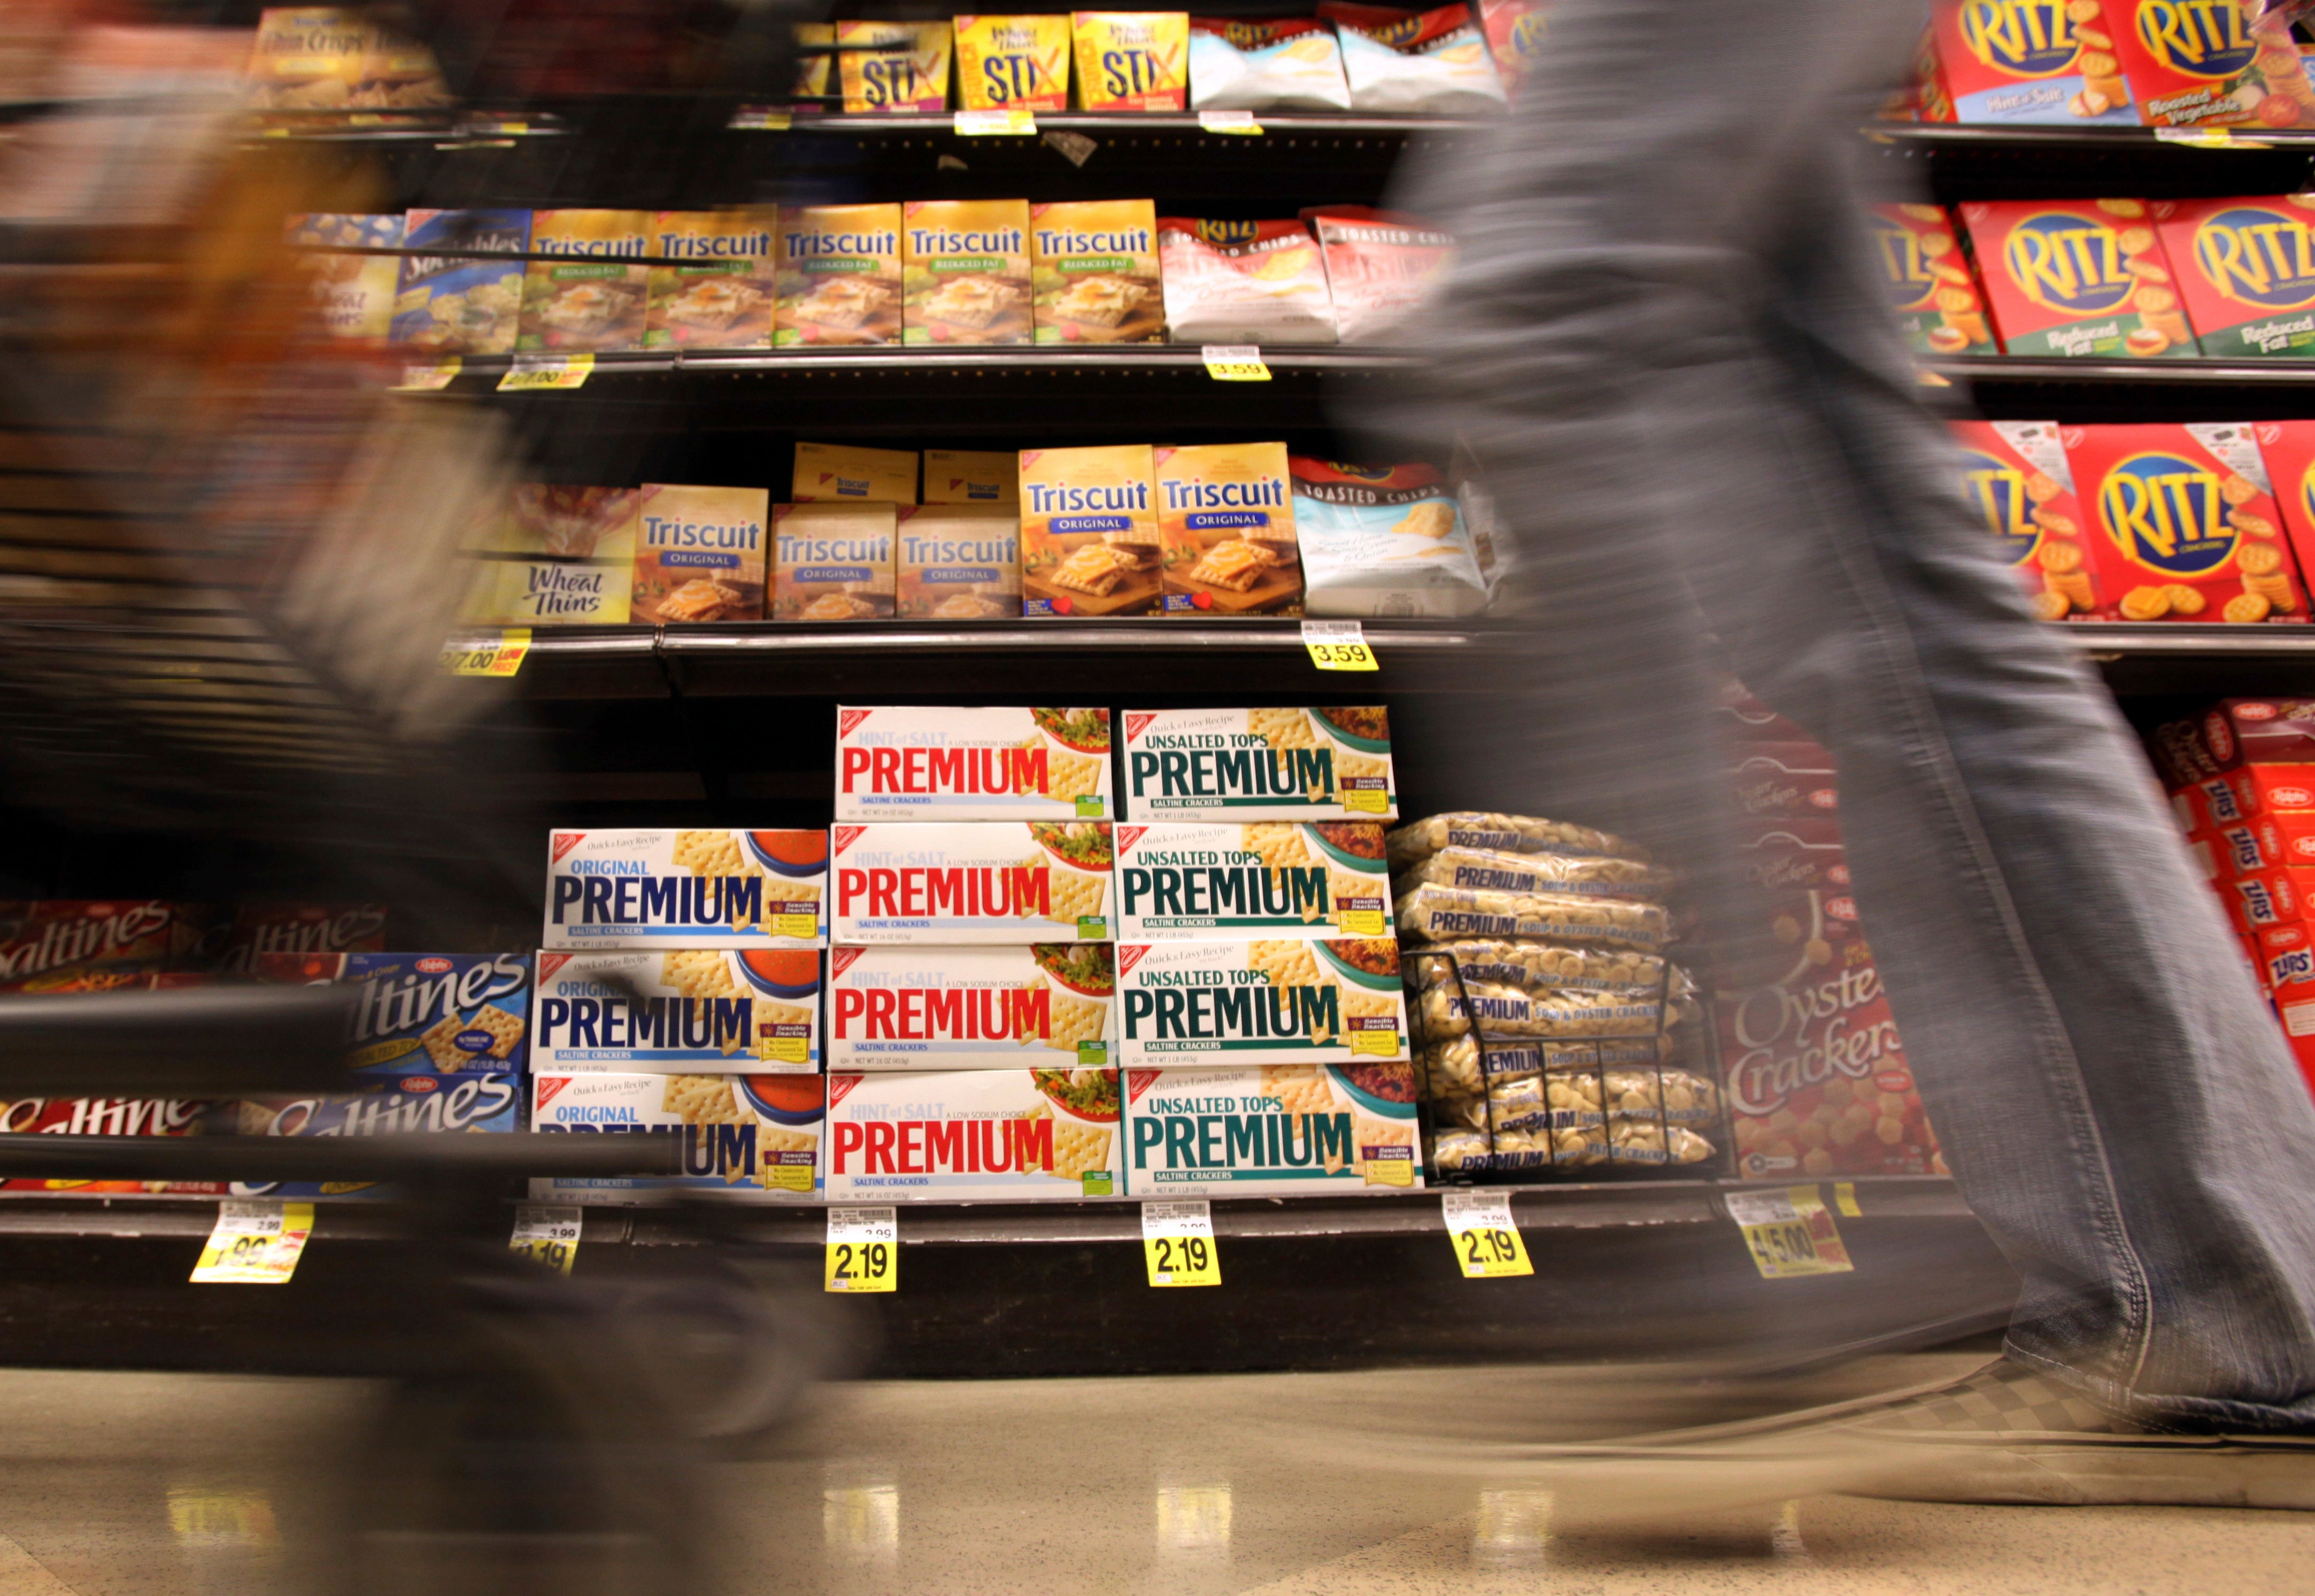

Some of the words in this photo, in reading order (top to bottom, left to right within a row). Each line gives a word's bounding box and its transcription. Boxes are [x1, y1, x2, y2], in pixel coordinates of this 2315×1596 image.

[1962, 0, 2084, 65] RITZ
[2137, 0, 2259, 68] RITZ
[984, 47, 1060, 103] STIX
[1103, 42, 1179, 98] STIX
[537, 234, 646, 257] Triscuit
[660, 230, 770, 256] Triscuit
[785, 229, 894, 257] Triscuit
[910, 227, 1022, 255] Triscuit
[1037, 225, 1149, 256] Triscuit
[1339, 227, 1410, 244] TOASTED
[936, 259, 980, 269] REDUCED
[982, 259, 999, 269] FAT
[1063, 259, 1109, 269] REDUCED
[1112, 259, 1129, 269] FAT
[2008, 226, 2133, 302] RITZ
[2197, 222, 2315, 298] RITZ
[2046, 321, 2119, 349] Reduced
[2240, 315, 2314, 344] Reduced
[2259, 334, 2289, 354] Fat
[1213, 363, 1262, 374] 3.59
[837, 477, 870, 489] Triscuit
[1027, 479, 1148, 513] Triscuit
[1162, 475, 1283, 508] Triscuit
[1305, 484, 1377, 504] TOASTED
[1387, 486, 1440, 503] CHIPS
[1059, 518, 1122, 529] ORIGINAL
[1195, 514, 1259, 526] ORIGINAL
[2104, 472, 2237, 560] RITZ
[644, 516, 759, 550] Triscuit
[670, 553, 730, 565] ORIGINAL
[776, 534, 889, 562] Triscuit
[904, 535, 1016, 563] Triscuit
[528, 564, 603, 593] Wheat
[804, 569, 861, 579] ORIGINAL
[931, 570, 989, 580] ORIGINAL
[523, 589, 600, 615] Thins
[1314, 644, 1368, 662] 3.59
[858, 732, 894, 746] HINT
[896, 734, 907, 745] of
[909, 732, 947, 746] SALT
[1145, 734, 1224, 749] UNSALTED
[1229, 734, 1269, 747] TOPS
[842, 747, 1049, 793] PREMIUM
[1131, 749, 1334, 797] PREMIUM
[1449, 830, 1521, 849] PREMIUM
[570, 859, 650, 875] ORIGINAL
[854, 852, 891, 867] HINT
[893, 853, 904, 865] of
[907, 852, 945, 866] SALT
[1137, 851, 1218, 866] UNSALTED
[1222, 851, 1263, 865] TOPS
[838, 867, 1051, 916] PREMIUM
[1122, 867, 1330, 916] PREMIUM
[1455, 866, 1536, 892] PREMIUM
[552, 876, 762, 924] PREMIUM
[572, 927, 602, 935] SALTINE
[1178, 919, 1215, 927] CRACKERS
[1431, 911, 1517, 934] PREMIUM
[0, 900, 169, 980] altines
[1145, 953, 1171, 966] Quick
[1179, 949, 1202, 961] Easy
[1203, 945, 1234, 958] Recipe
[557, 981, 635, 997] ORIGIN
[851, 973, 889, 987] HINT
[891, 973, 902, 985] of
[905, 972, 945, 988] SALT
[1139, 970, 1223, 986] UNSALTED
[1228, 969, 1270, 984] TOPS
[351, 953, 526, 1044] ltines
[539, 997, 752, 1048] PREMIUM
[834, 989, 1051, 1039] PREMIUM
[1123, 985, 1340, 1039] PREMIUM
[1147, 1043, 1179, 1051] SALTINE
[1180, 1042, 1221, 1050] CRACKERS
[555, 1106, 638, 1122] ORIGINAL
[850, 1104, 889, 1120] HINT
[890, 1106, 902, 1118] of
[905, 1103, 945, 1120] SALT
[1149, 1098, 1236, 1114] UNSALTED
[1240, 1096, 1283, 1112] TOPS
[833, 1119, 1054, 1175] PREMIUM
[1133, 1113, 1354, 1169] PREMIUM
[591, 1178, 632, 1188] CRACKERS
[1156, 1173, 1189, 1181] SALTINE
[1191, 1171, 1232, 1180] CRACKERS
[1155, 1237, 1208, 1273] 2.19
[1462, 1229, 1516, 1263] 2.19
[835, 1244, 887, 1278] 2.19
